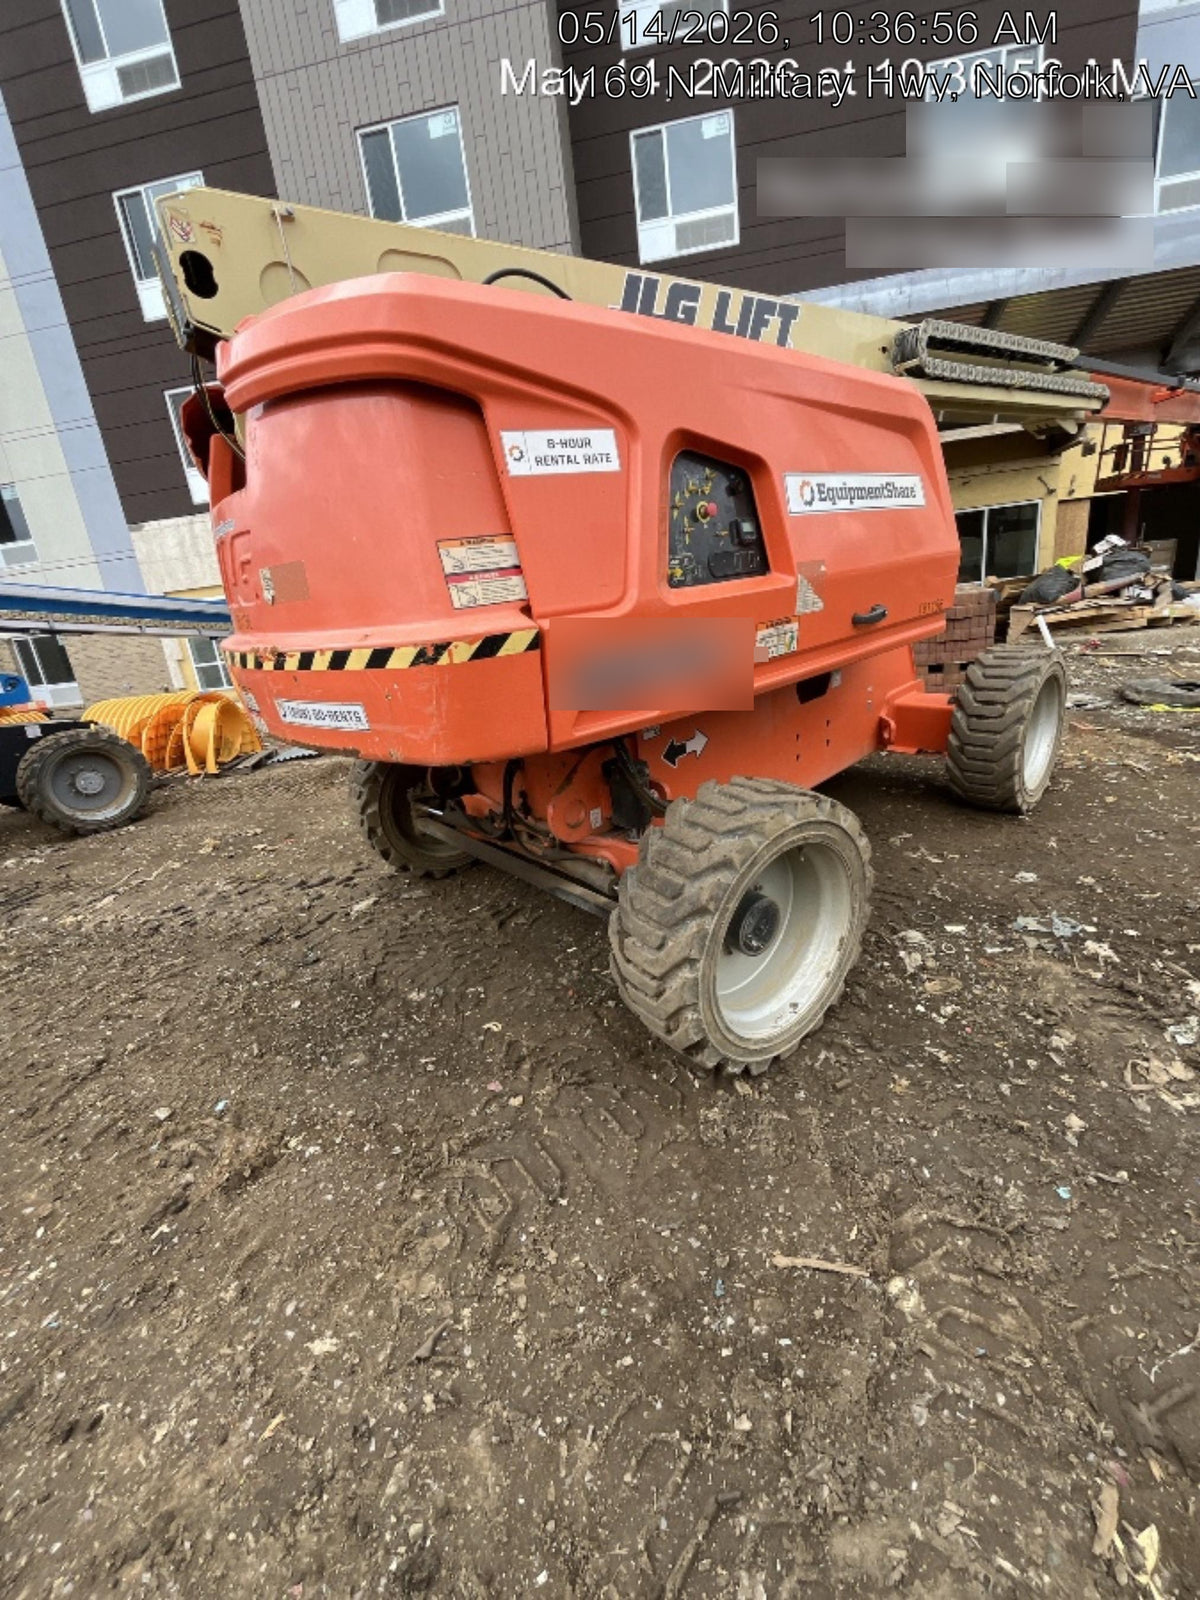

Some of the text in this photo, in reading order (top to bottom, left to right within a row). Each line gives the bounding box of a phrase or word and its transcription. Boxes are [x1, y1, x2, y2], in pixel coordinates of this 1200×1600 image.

[608, 271, 801, 349] JLG LIFT
[534, 452, 613, 467] RENTAL RATE
[815, 481, 917, 506] EquipmentShare
